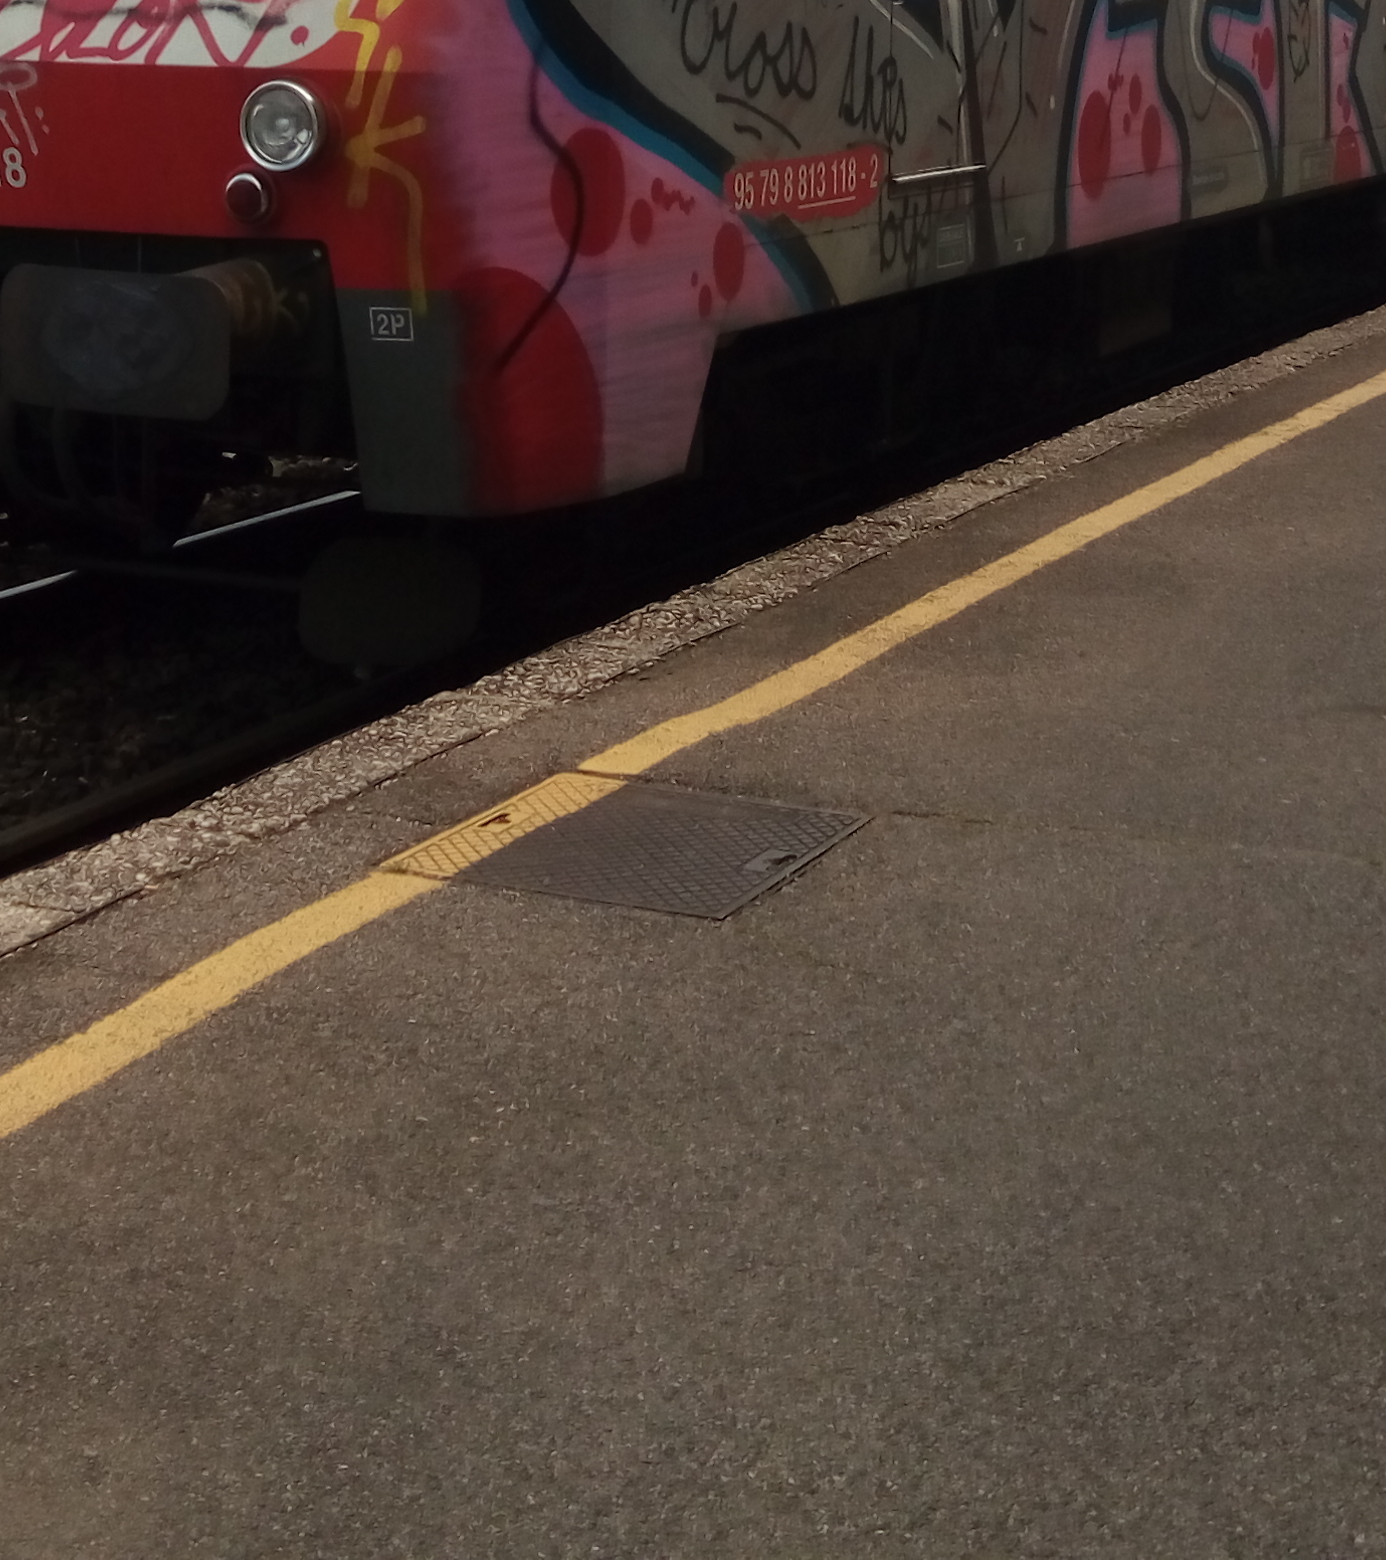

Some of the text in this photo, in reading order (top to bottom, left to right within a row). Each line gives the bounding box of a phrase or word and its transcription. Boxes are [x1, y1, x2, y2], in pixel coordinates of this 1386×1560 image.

[734, 171, 755, 210] 95
[760, 168, 779, 206] 79
[784, 165, 794, 203] 8
[798, 160, 826, 201] 813
[376, 313, 405, 336] 2P
